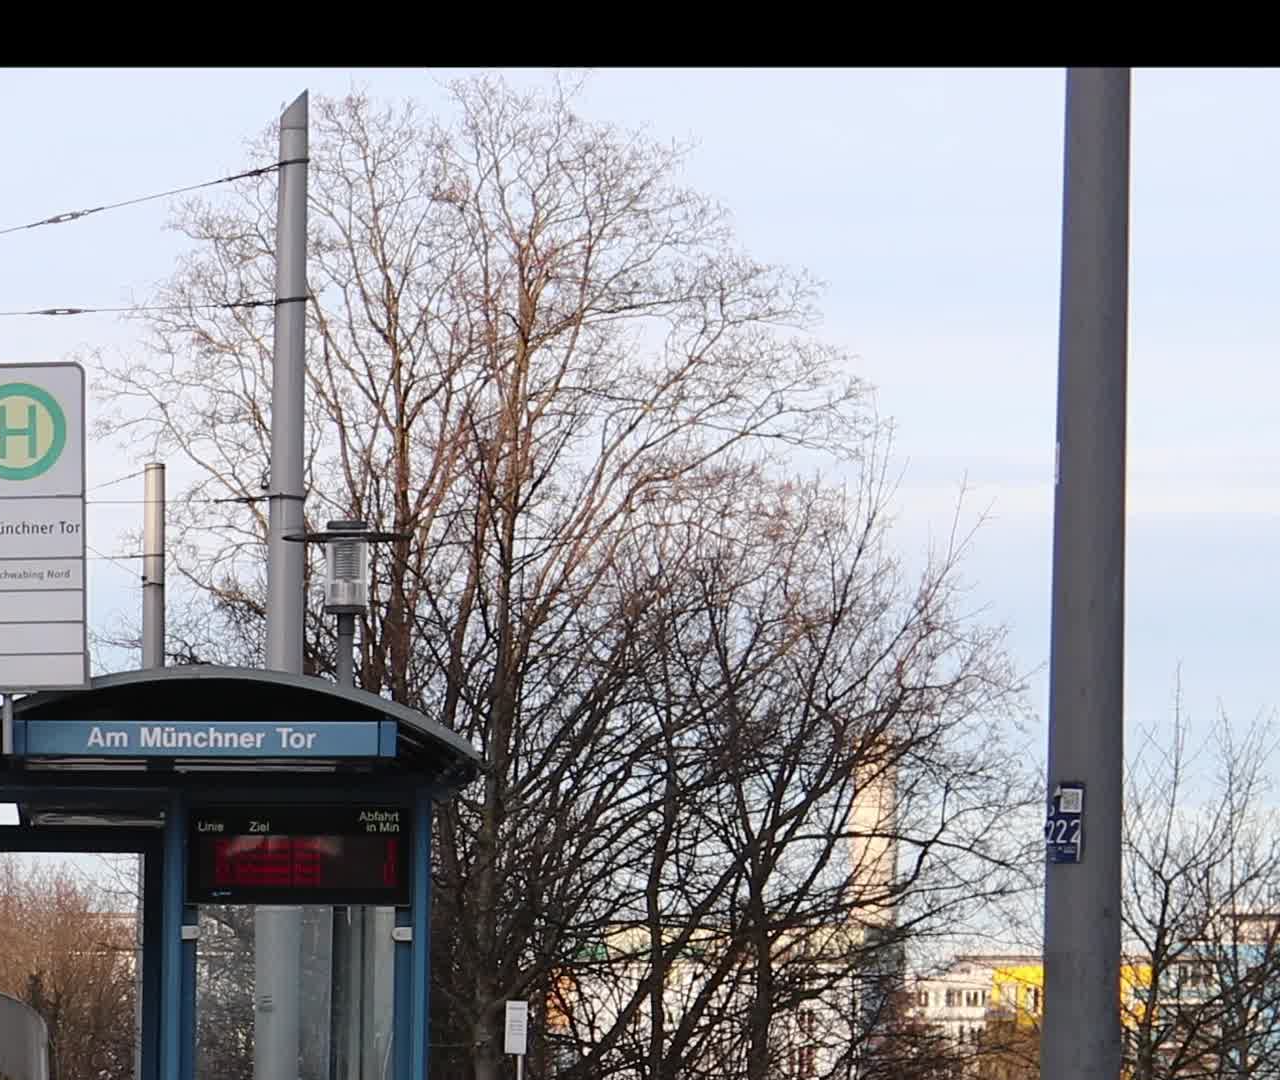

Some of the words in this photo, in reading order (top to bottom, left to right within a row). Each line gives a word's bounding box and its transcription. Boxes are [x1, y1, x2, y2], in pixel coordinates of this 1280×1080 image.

[59, 520, 81, 534] Tor
[47, 568, 71, 579] Nord
[87, 727, 128, 748] Am
[140, 726, 266, 749] Münchner
[276, 727, 317, 749] Tor
[359, 811, 400, 822] Abfahrt
[197, 821, 225, 832] Linie
[249, 821, 270, 832] Ziel
[366, 822, 376, 832] in
[379, 822, 400, 832] Min
